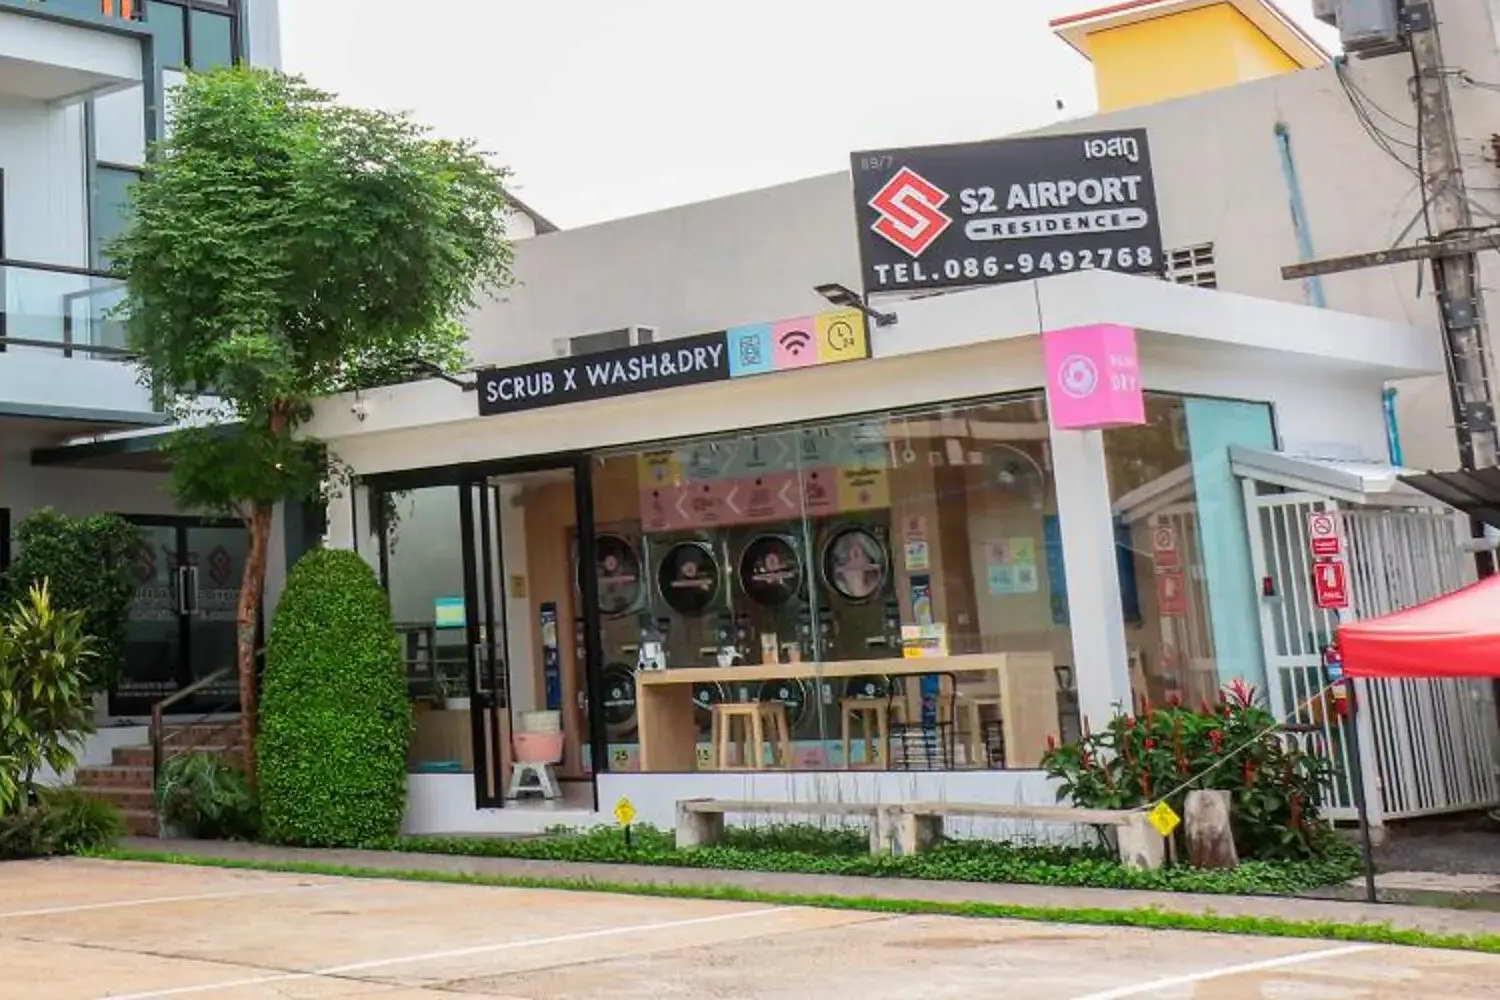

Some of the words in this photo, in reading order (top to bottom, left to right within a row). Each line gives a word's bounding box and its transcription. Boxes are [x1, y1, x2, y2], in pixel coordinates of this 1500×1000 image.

[959, 186, 998, 214] S2
[1006, 175, 1142, 211] AIRPORT
[992, 213, 1121, 236] RESIDENCE
[486, 371, 555, 403] SCRUB
[563, 368, 577, 392] X
[586, 343, 723, 388] WASH&DRY
